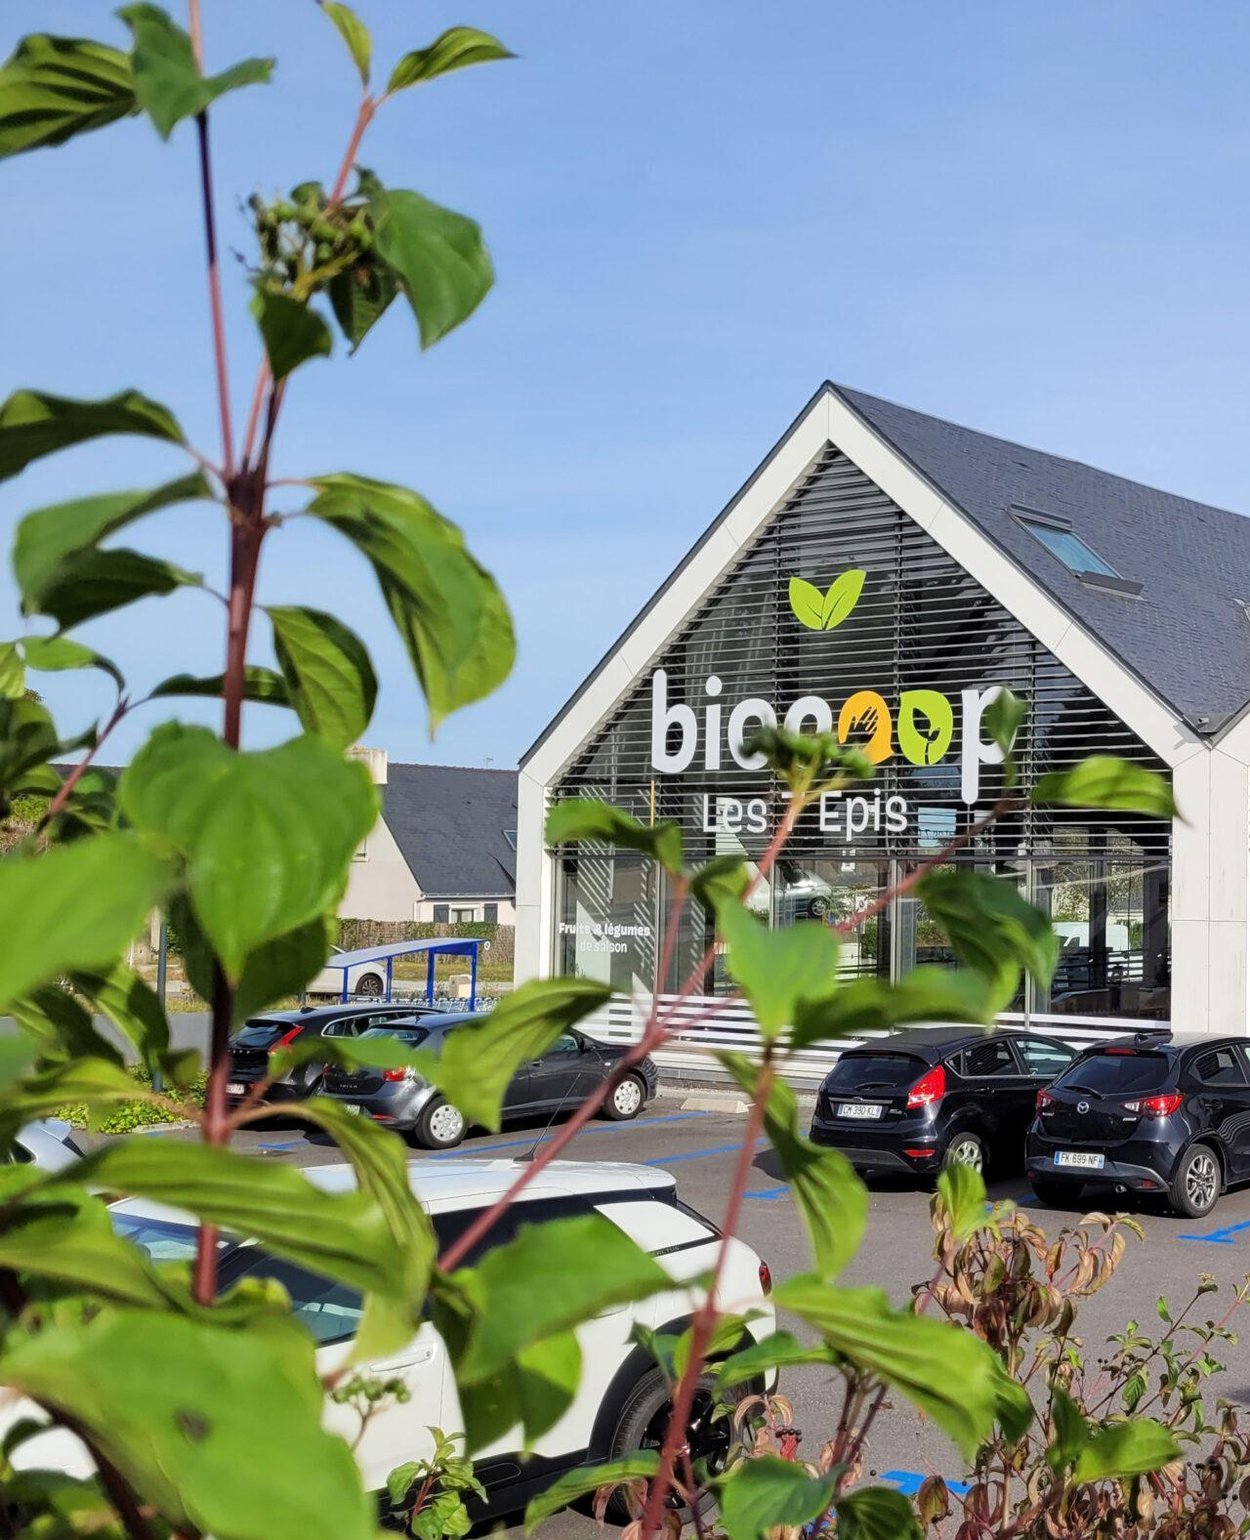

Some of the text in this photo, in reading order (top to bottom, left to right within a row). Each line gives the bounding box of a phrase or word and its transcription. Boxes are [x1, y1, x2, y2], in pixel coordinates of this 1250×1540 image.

[703, 793, 768, 834] Les
[819, 788, 907, 842] Epis
[559, 922, 651, 938] Fruits & légumes
[580, 940, 628, 953] de saison
